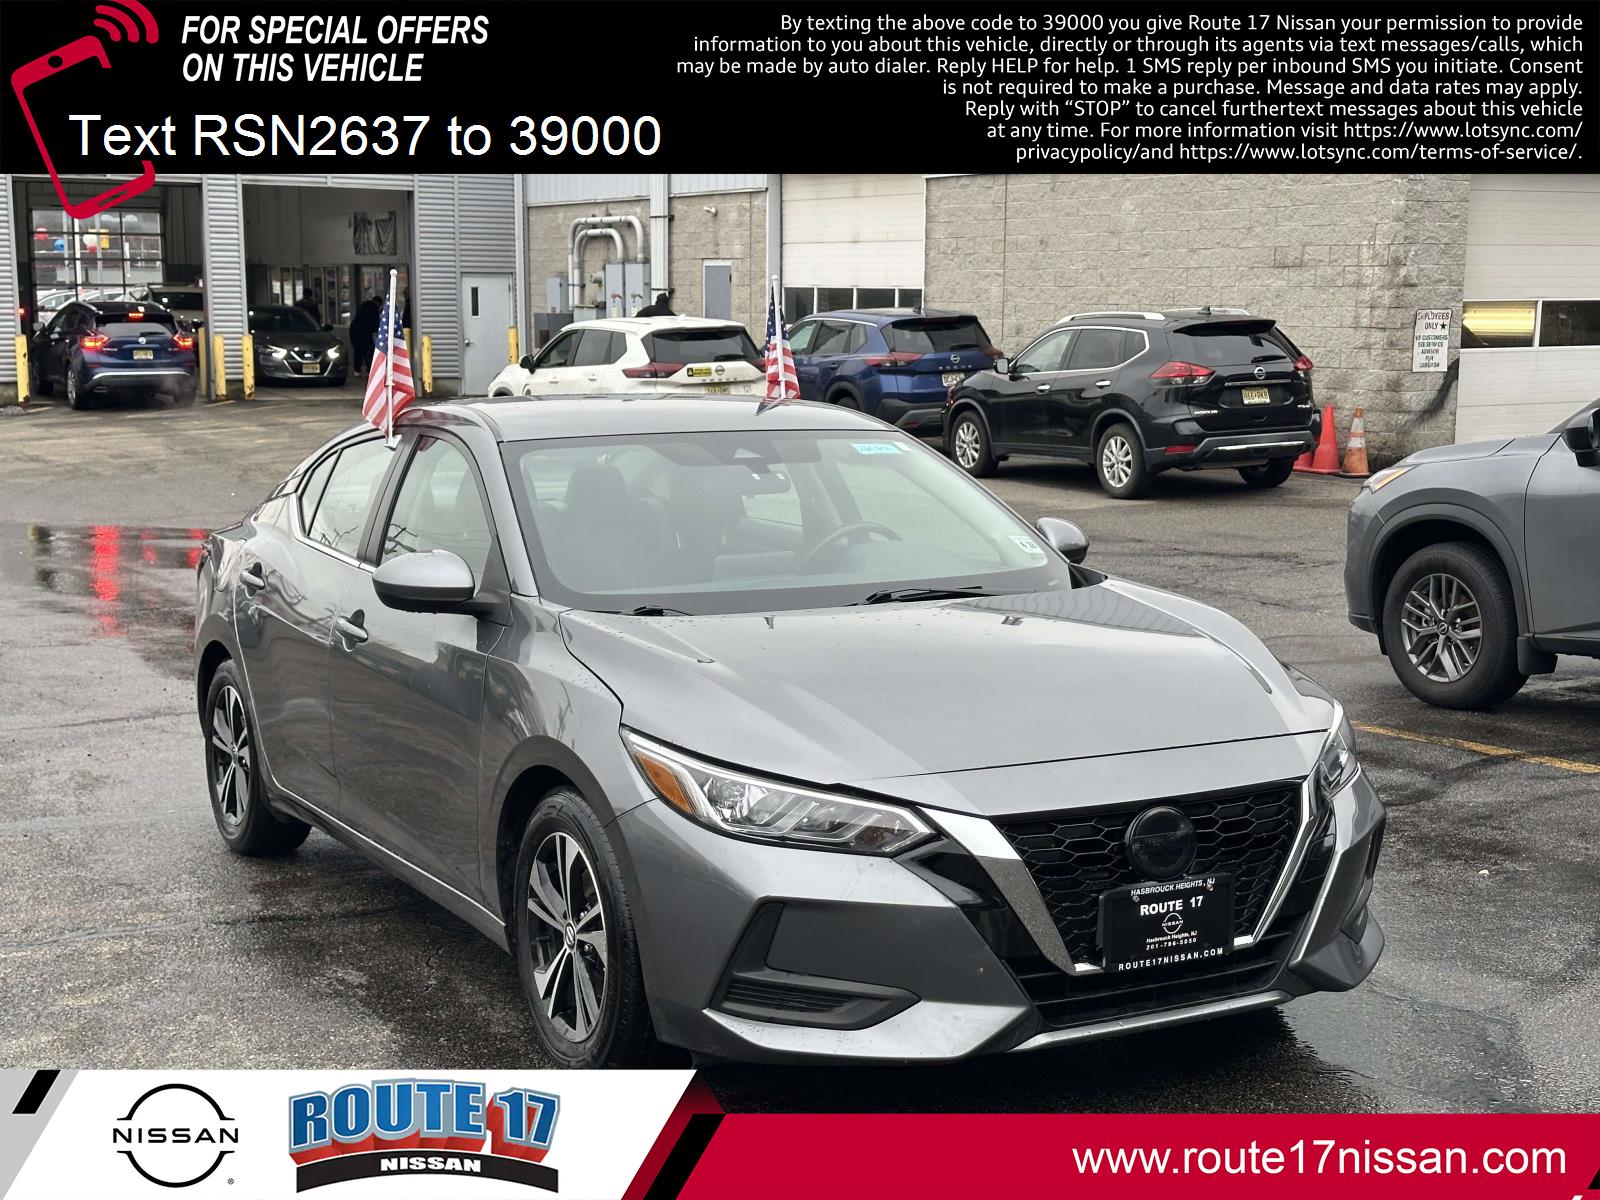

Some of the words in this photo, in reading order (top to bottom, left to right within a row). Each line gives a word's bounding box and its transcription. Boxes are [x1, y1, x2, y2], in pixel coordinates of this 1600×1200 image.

[1130, 884, 1174, 896] HASBROUCK
[1207, 877, 1216, 885] NJ
[1140, 899, 1183, 916] ROUTE
[1189, 895, 1204, 908] 17
[1161, 919, 1184, 927] NISSAN
[1118, 947, 1223, 971] ROUTE17NISSAN.COM
